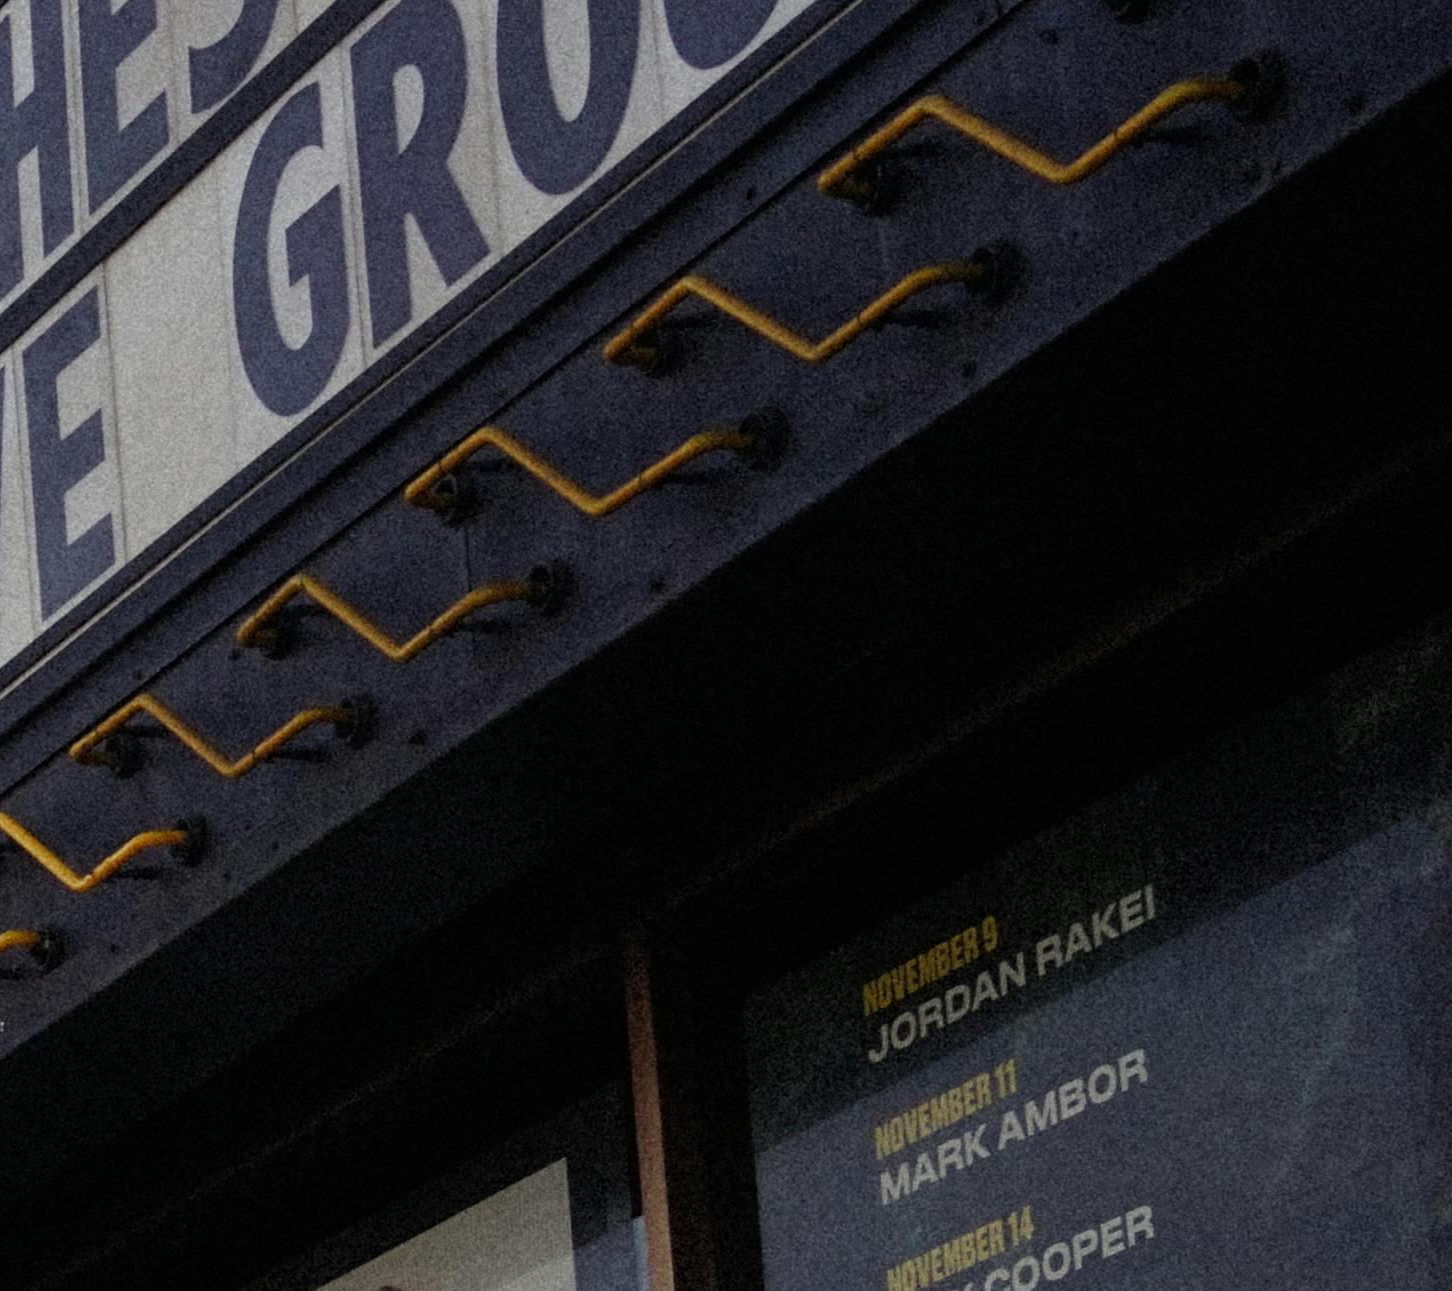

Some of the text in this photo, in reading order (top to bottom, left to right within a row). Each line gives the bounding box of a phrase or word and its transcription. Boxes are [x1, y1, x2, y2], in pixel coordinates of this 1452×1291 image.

[868, 883, 1157, 1063] JORDAN RAKEI
[880, 1049, 1149, 1206] MARK AMBOR
